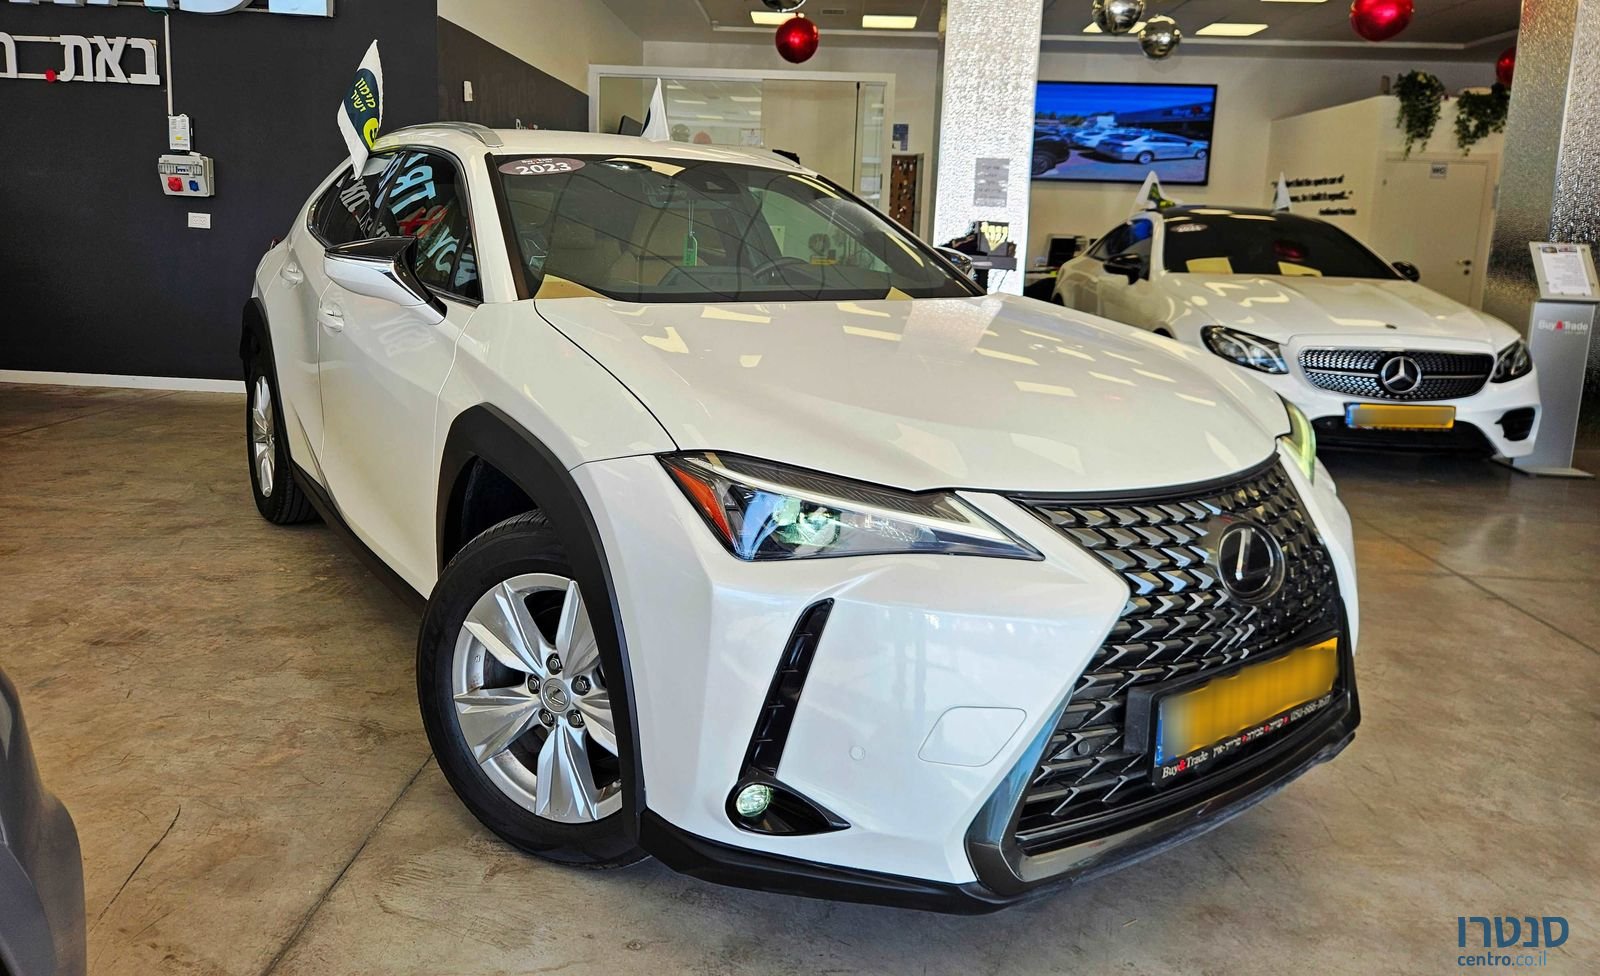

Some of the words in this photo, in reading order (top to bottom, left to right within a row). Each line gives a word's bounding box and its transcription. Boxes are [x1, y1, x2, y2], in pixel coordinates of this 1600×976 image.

[350, 89, 367, 112] ישיר
[355, 77, 376, 109] מימון
[515, 162, 572, 176] 2023
